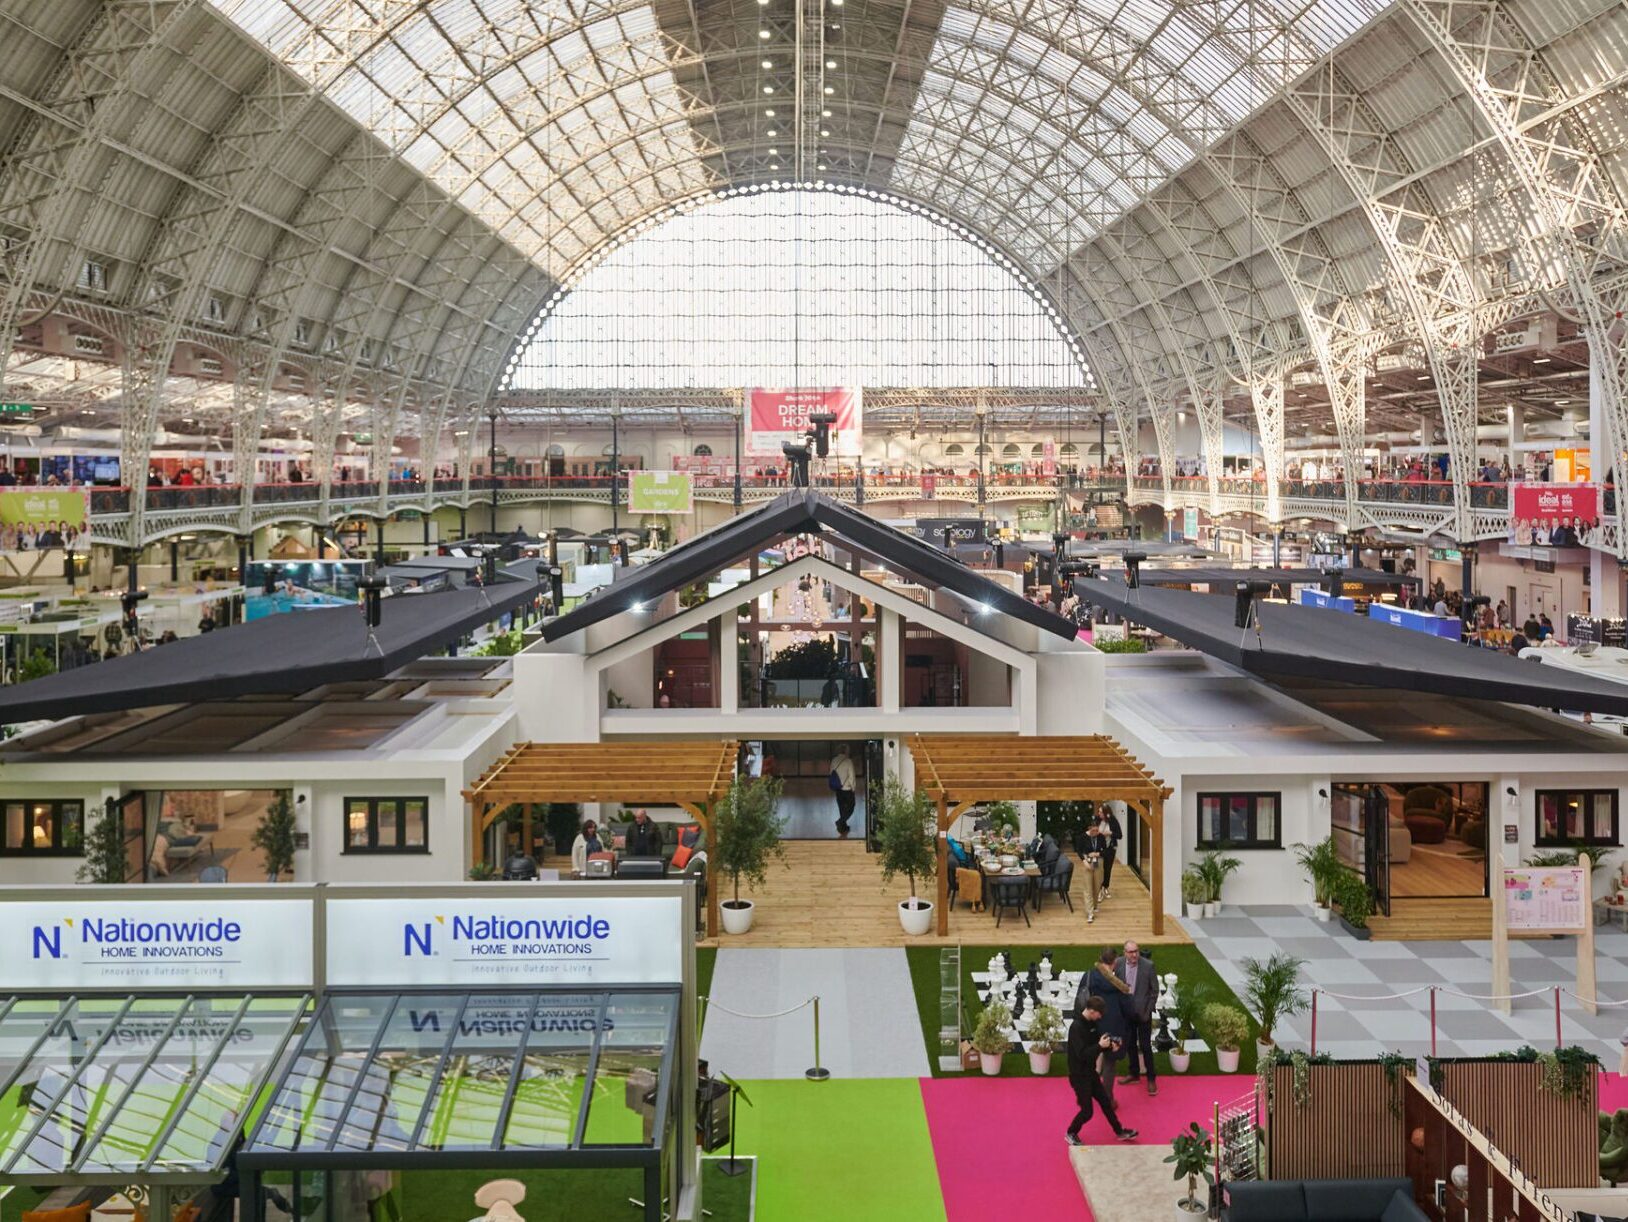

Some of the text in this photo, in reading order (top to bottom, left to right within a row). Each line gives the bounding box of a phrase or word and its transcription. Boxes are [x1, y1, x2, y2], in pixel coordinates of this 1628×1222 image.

[778, 404, 828, 416] DREAM
[782, 416, 815, 427] HOM
[933, 528, 976, 539] soology
[82, 917, 241, 942] Nationwide
[453, 915, 610, 940] Nationwide
[33, 926, 61, 958] N
[405, 923, 431, 955] N
[101, 946, 223, 957] HOME INNOVATIONS
[472, 943, 592, 954] HOME INNOVATIONS
[1432, 1084, 1473, 1137] Sofas
